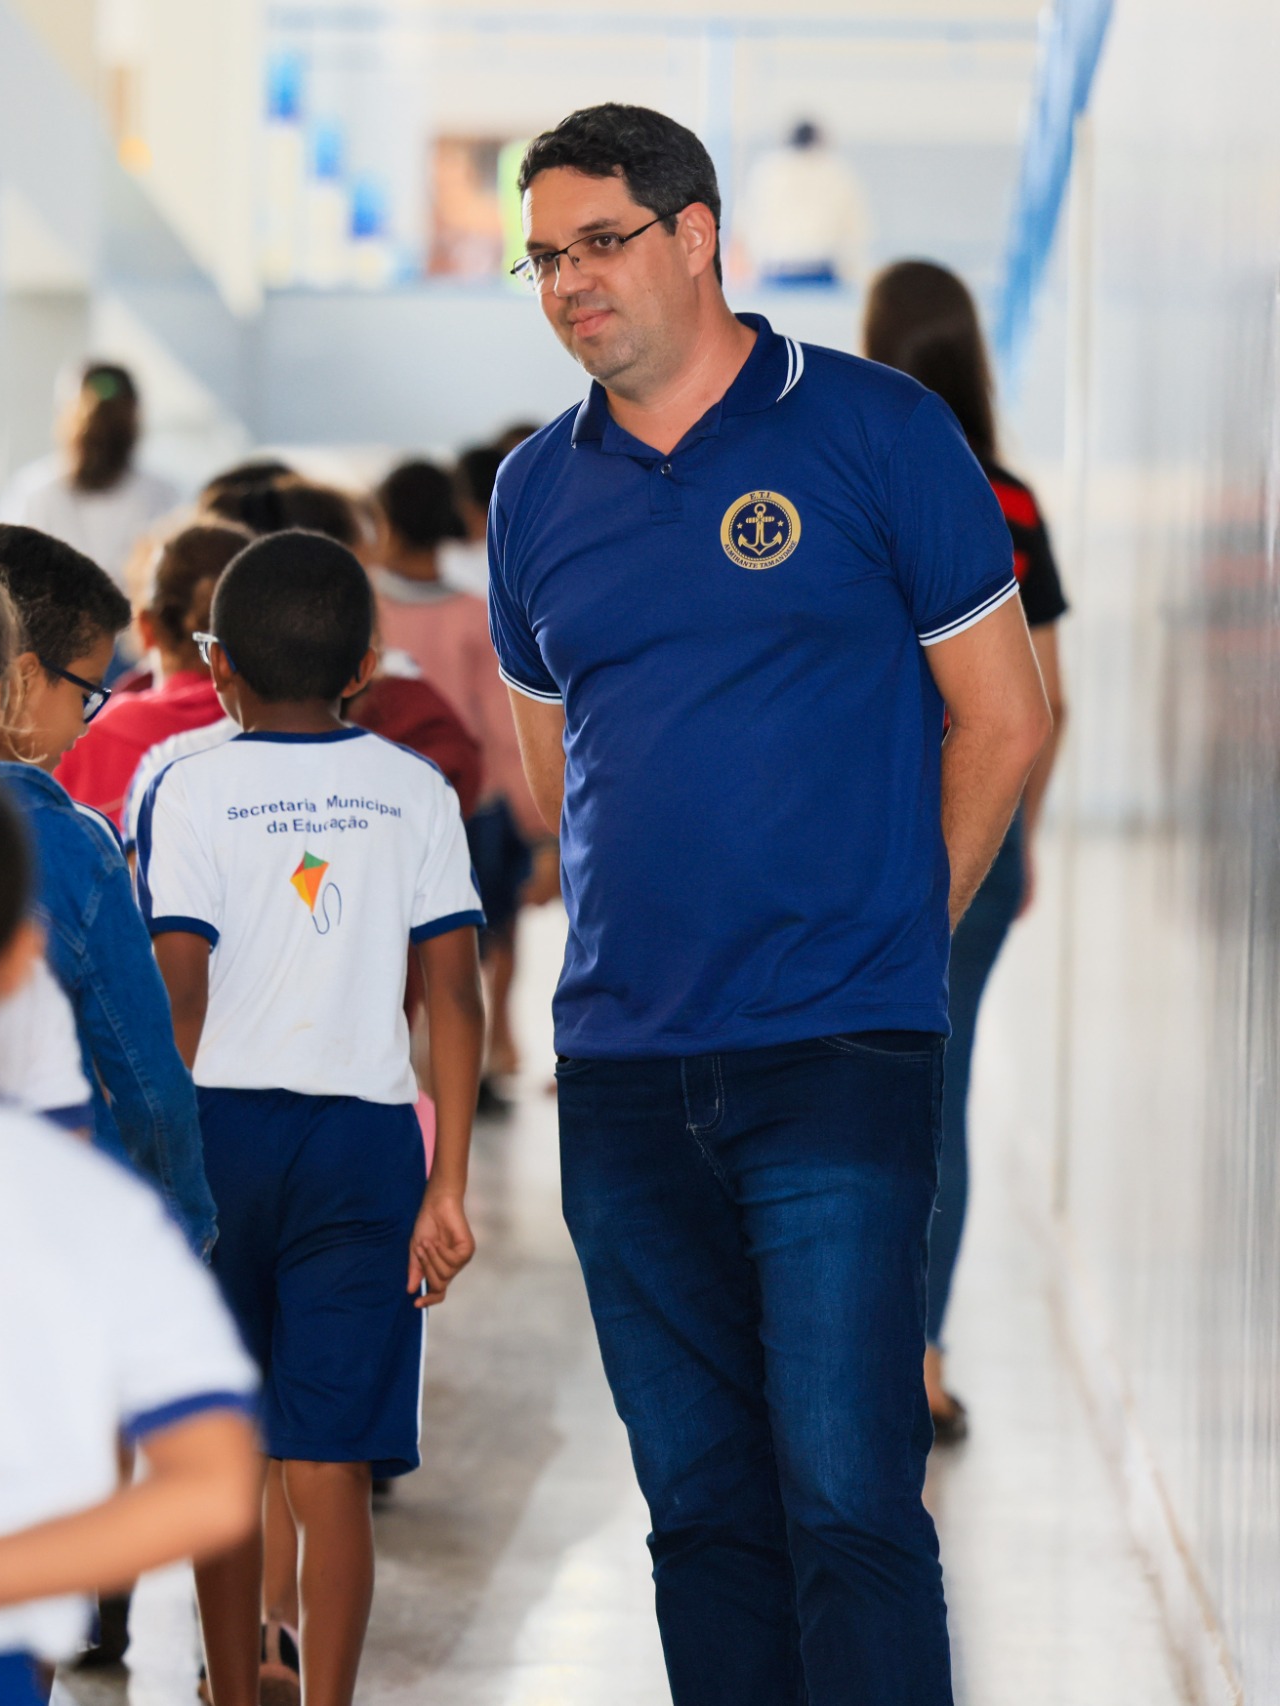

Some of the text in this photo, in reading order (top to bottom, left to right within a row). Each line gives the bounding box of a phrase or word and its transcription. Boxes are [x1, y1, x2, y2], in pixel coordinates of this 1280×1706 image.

[724, 543, 758, 568] ALMIRANTE
[227, 795, 402, 820] Secretaria Municipal
[266, 819, 288, 834] da
